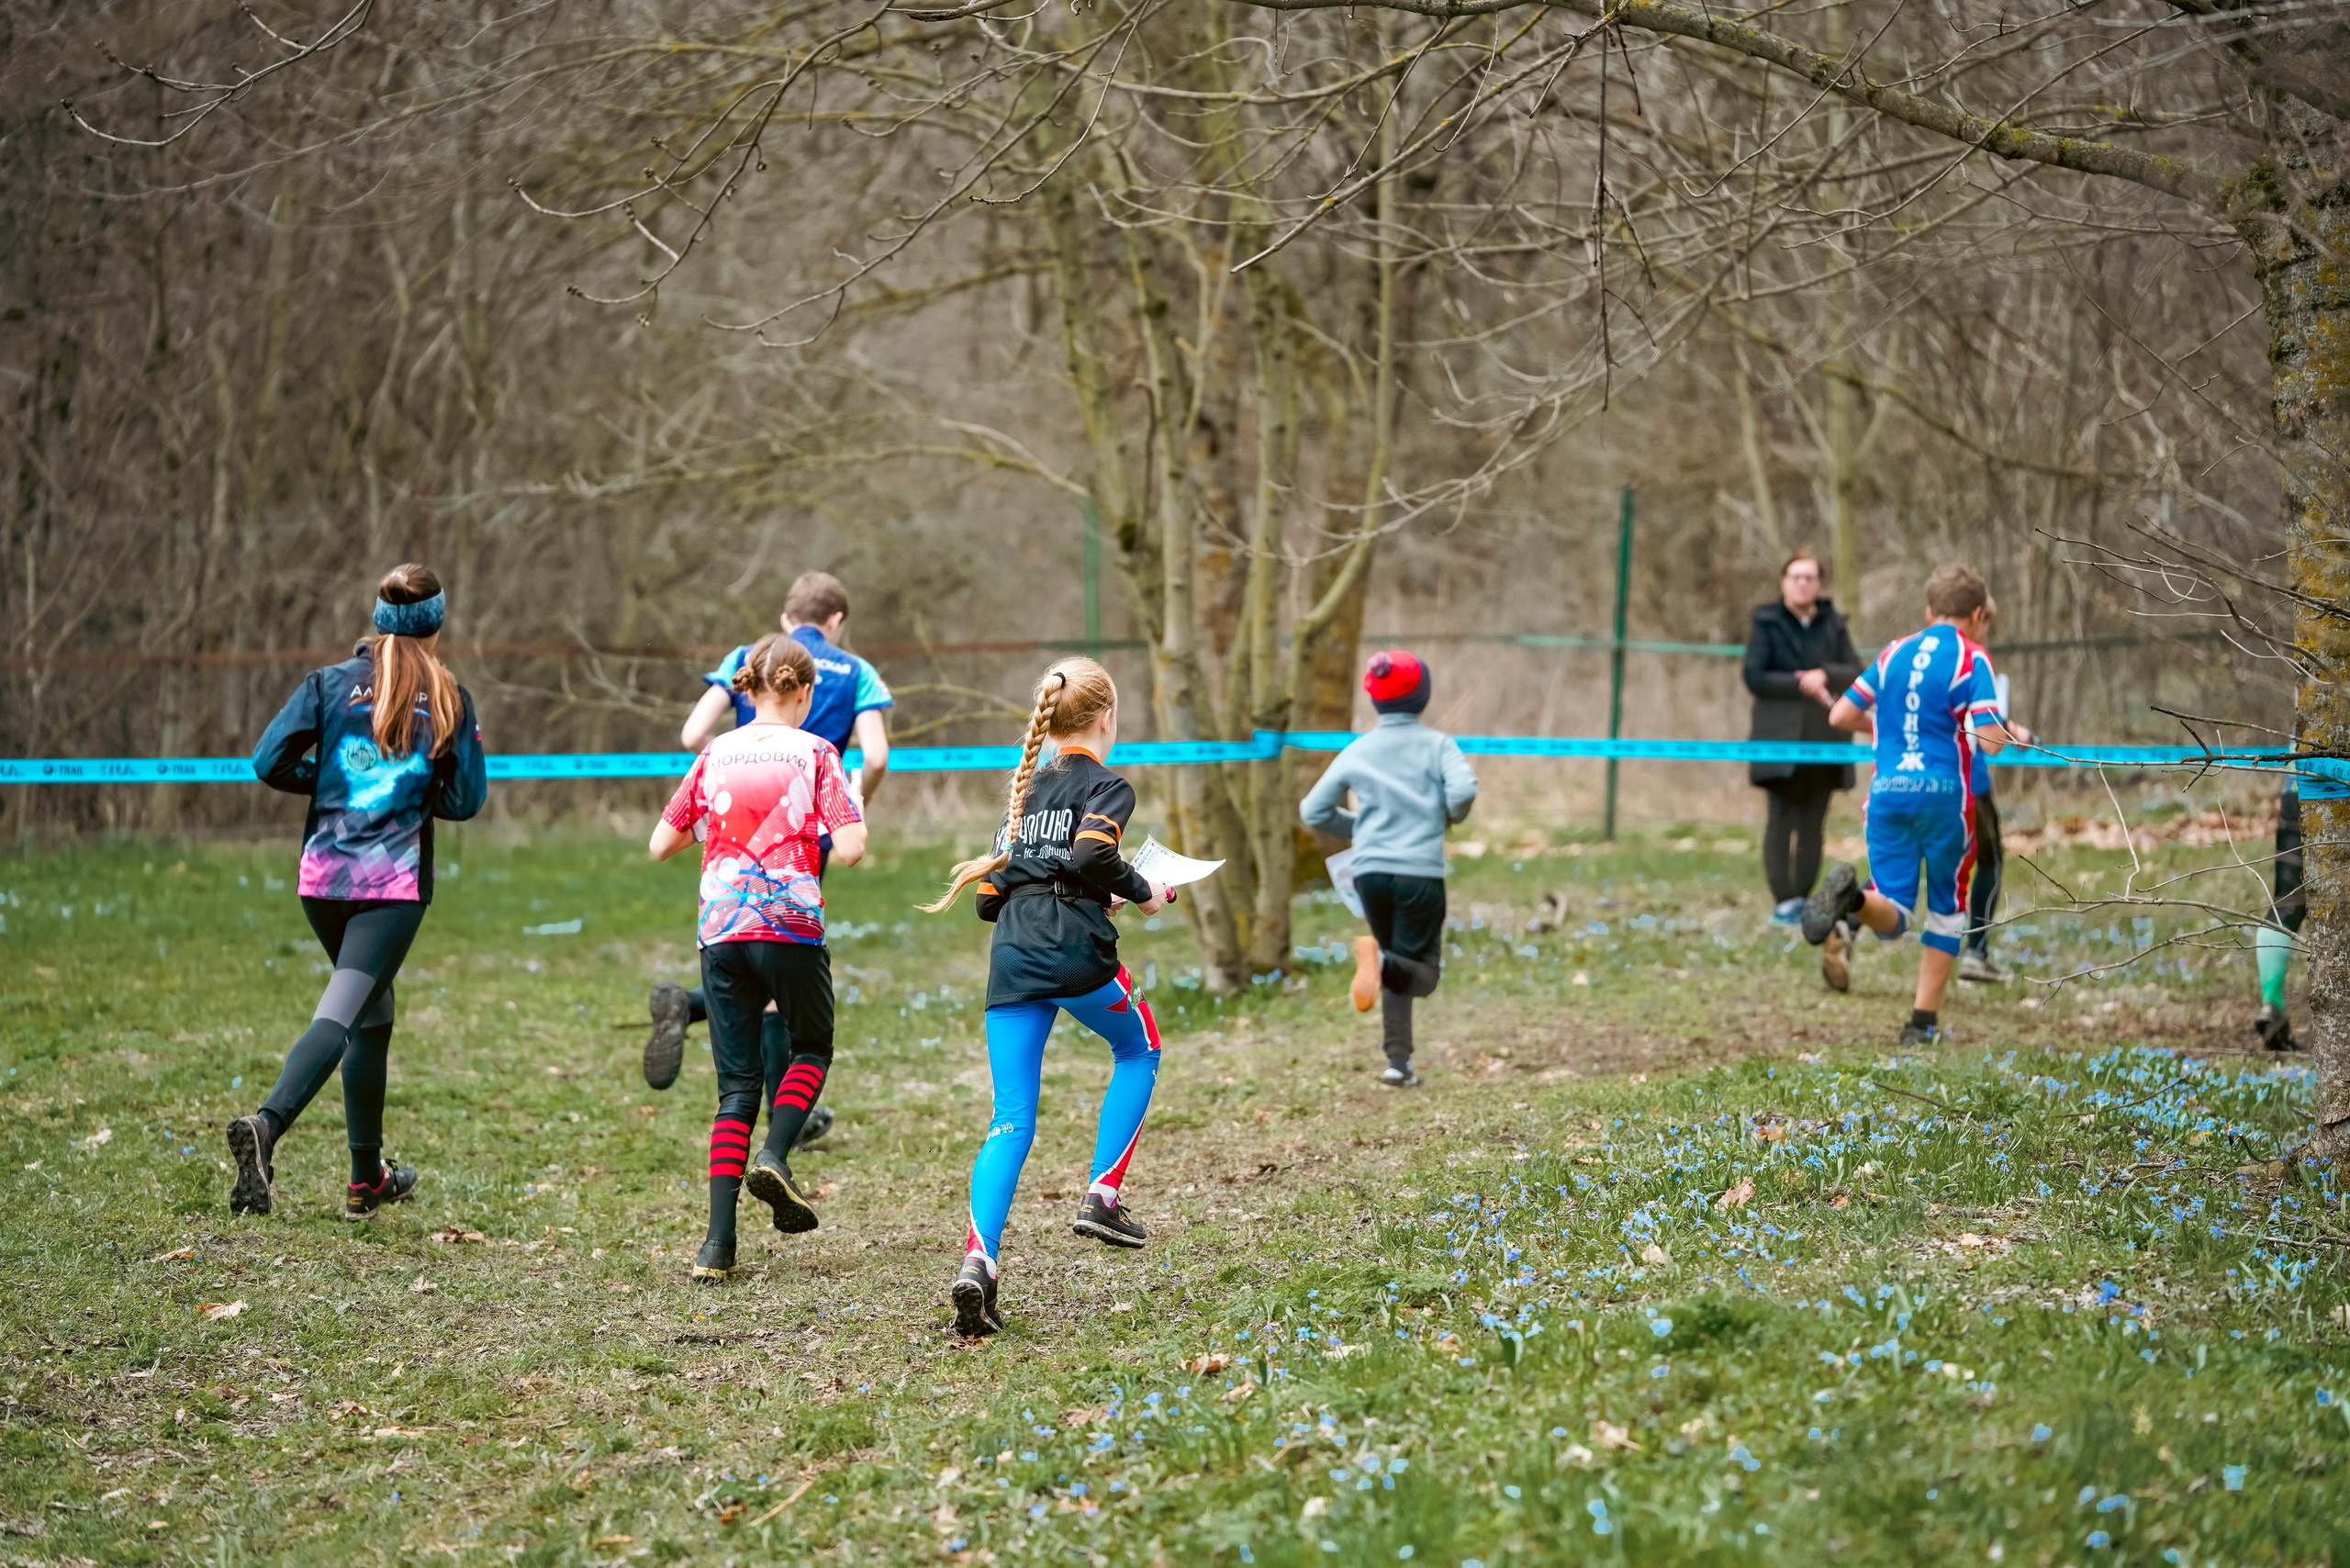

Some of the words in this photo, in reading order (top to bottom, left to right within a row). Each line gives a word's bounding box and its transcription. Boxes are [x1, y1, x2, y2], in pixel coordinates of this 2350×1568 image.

[1895, 635, 1940, 772] ВОРОНЕЖ
[711, 752, 808, 771] МОРДОВИЯ
[1024, 847, 1036, 859] НЕ
